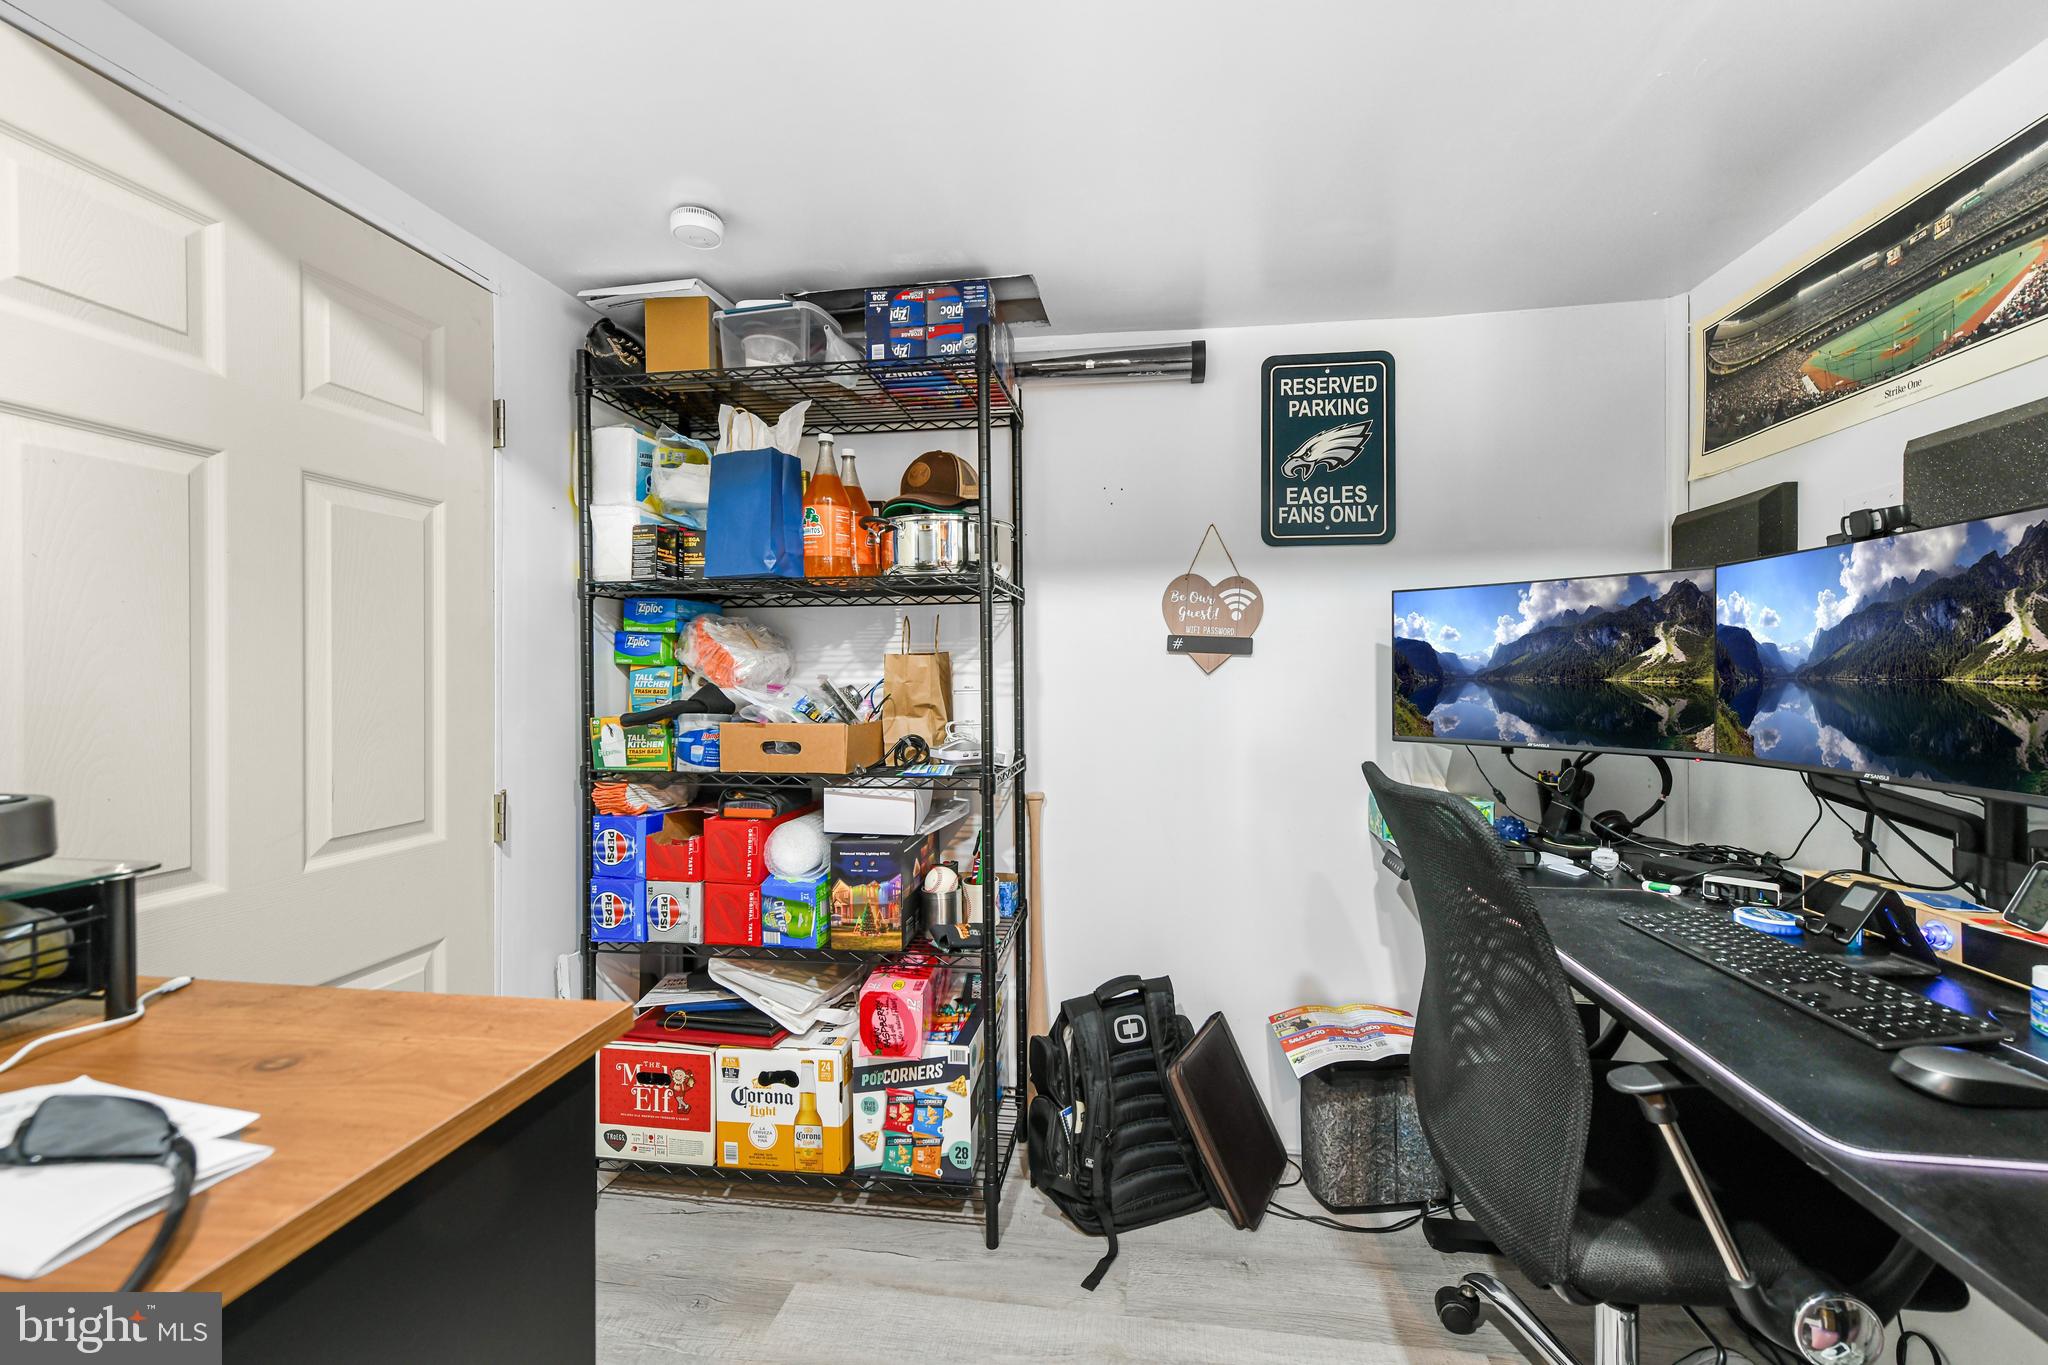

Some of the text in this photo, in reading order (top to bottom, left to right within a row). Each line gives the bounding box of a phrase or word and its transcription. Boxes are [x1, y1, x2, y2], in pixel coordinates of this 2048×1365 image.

[1280, 375, 1377, 396] RESERVED
[1884, 385, 1906, 399] Strike
[1907, 379, 1922, 390] One
[1288, 398, 1369, 418] PARKING
[1286, 485, 1368, 505] EAGLES
[1278, 504, 1379, 524] FANS ONLY
[1170, 590, 1215, 605] Be Our
[638, 602, 663, 615] Ziploc
[1178, 606, 1220, 622] Guest!
[1186, 625, 1235, 636] WIFI PASSWORD
[627, 636, 650, 648] Ziploc
[908, 998, 916, 1011] 12
[821, 1062, 831, 1071] 24
[862, 1063, 944, 1086] POPCORNERS
[631, 1087, 673, 1113] Elf
[731, 1086, 794, 1108] Corona
[749, 1104, 776, 1117] Light
[955, 1147, 968, 1159] 28
